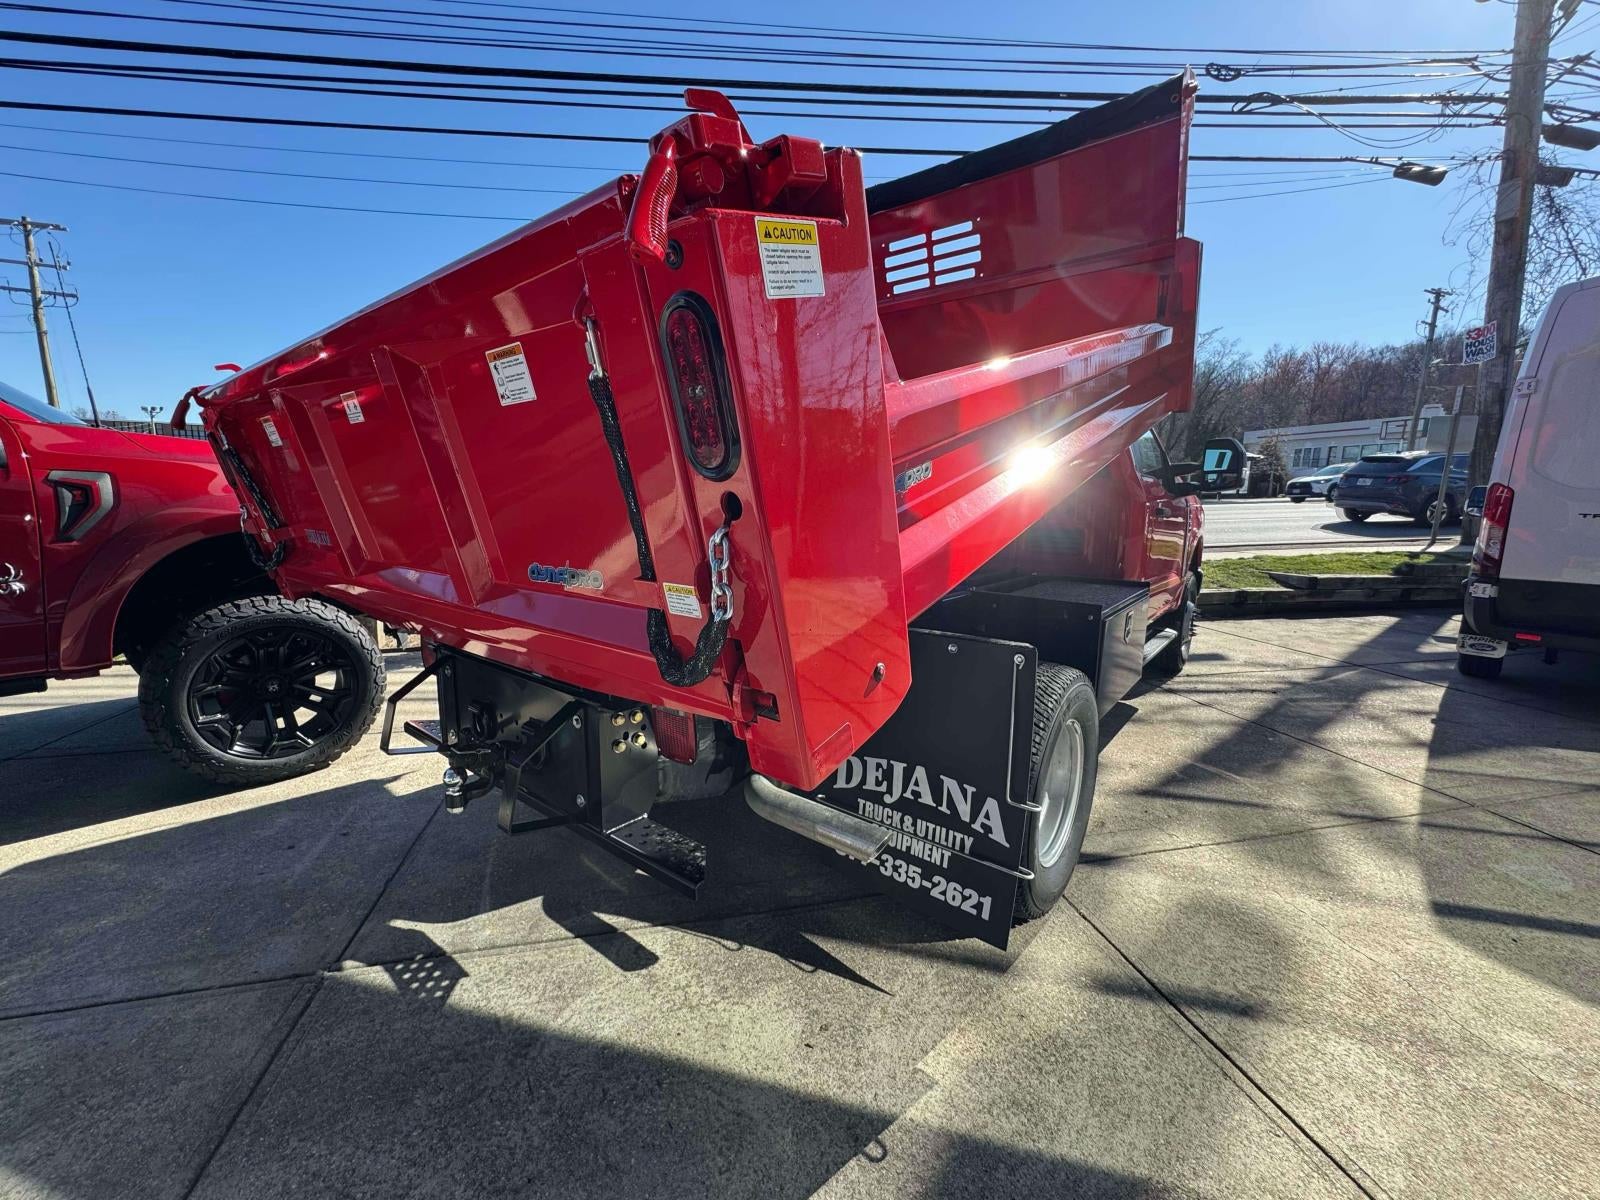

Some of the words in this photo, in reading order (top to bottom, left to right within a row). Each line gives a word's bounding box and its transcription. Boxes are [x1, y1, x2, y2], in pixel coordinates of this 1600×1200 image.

[773, 227, 812, 240] CAUTION
[1464, 334, 1496, 350] HOUSE
[1465, 343, 1495, 358] WASH
[833, 756, 1010, 848] DEJANA
[857, 798, 902, 830] TRUCK
[902, 814, 915, 834] &
[916, 818, 974, 854] UTILITY
[835, 848, 992, 921] -335-2621
